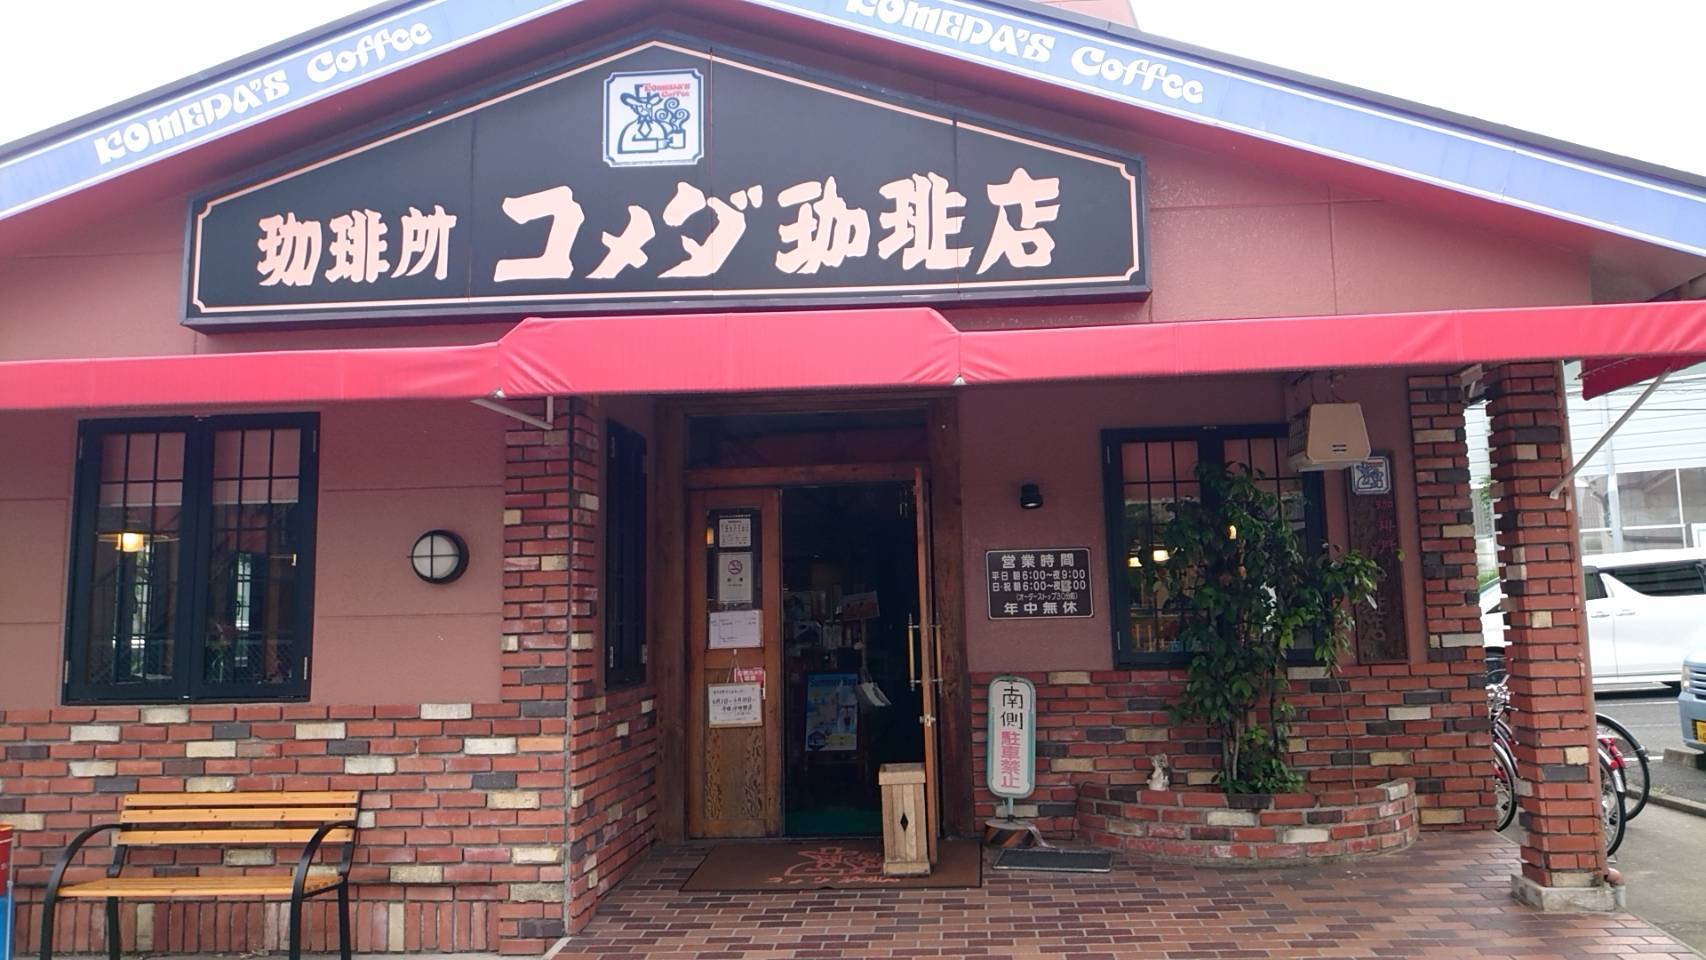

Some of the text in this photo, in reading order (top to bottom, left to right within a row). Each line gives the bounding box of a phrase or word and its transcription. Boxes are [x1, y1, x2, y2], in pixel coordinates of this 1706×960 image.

[94, 23, 433, 165] KOMEDA'S Coffee
[1071, 46, 1204, 104] Coffee
[257, 167, 1061, 286] 珈琲所 コメダ珈琲店
[1001, 553, 1074, 569] 営業時間
[1004, 601, 1078, 615] 年中無休
